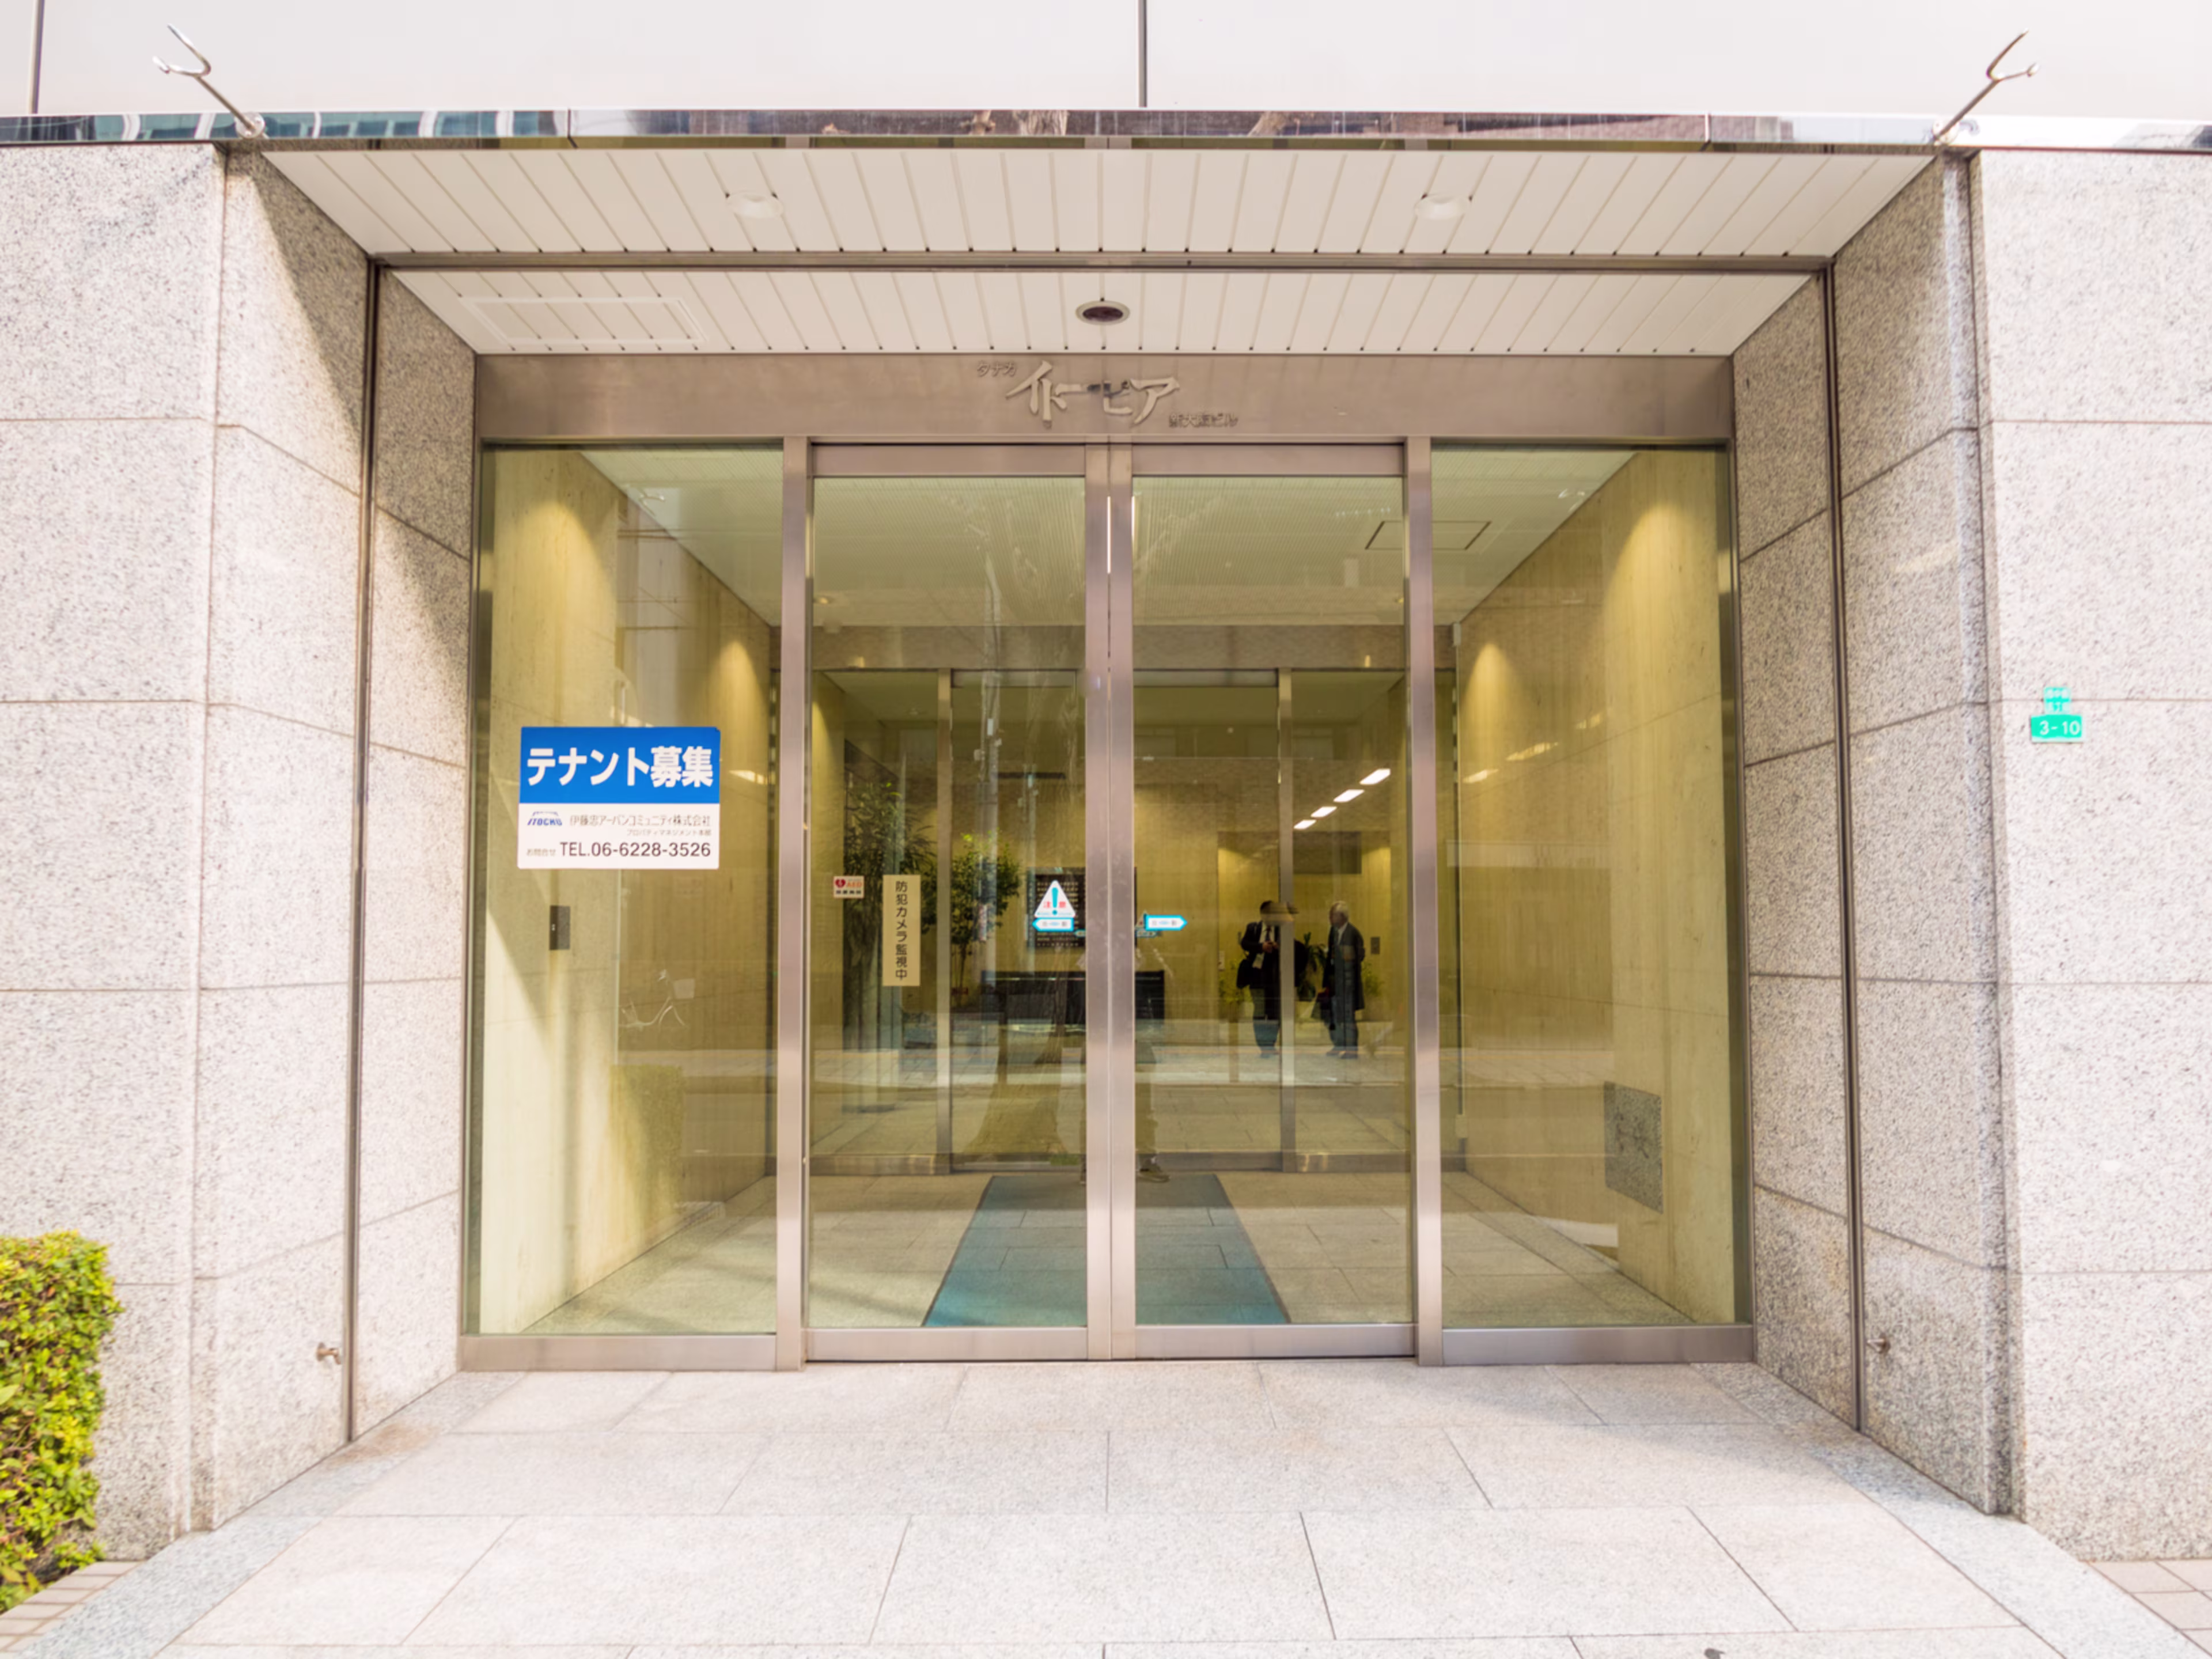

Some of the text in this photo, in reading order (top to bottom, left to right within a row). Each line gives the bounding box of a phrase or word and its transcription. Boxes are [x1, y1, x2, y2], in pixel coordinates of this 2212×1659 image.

[976, 360, 1017, 377] タナカ
[1005, 360, 1180, 429] イトーピア
[2040, 720, 2080, 736] 3-10
[527, 746, 713, 787] テナント募集
[570, 815, 710, 827] 伊藤忠アーバンコミュニティ株式会社
[560, 842, 710, 857] TEL.06-6228-3526
[895, 880, 908, 980] 防犯カメラ監視中
